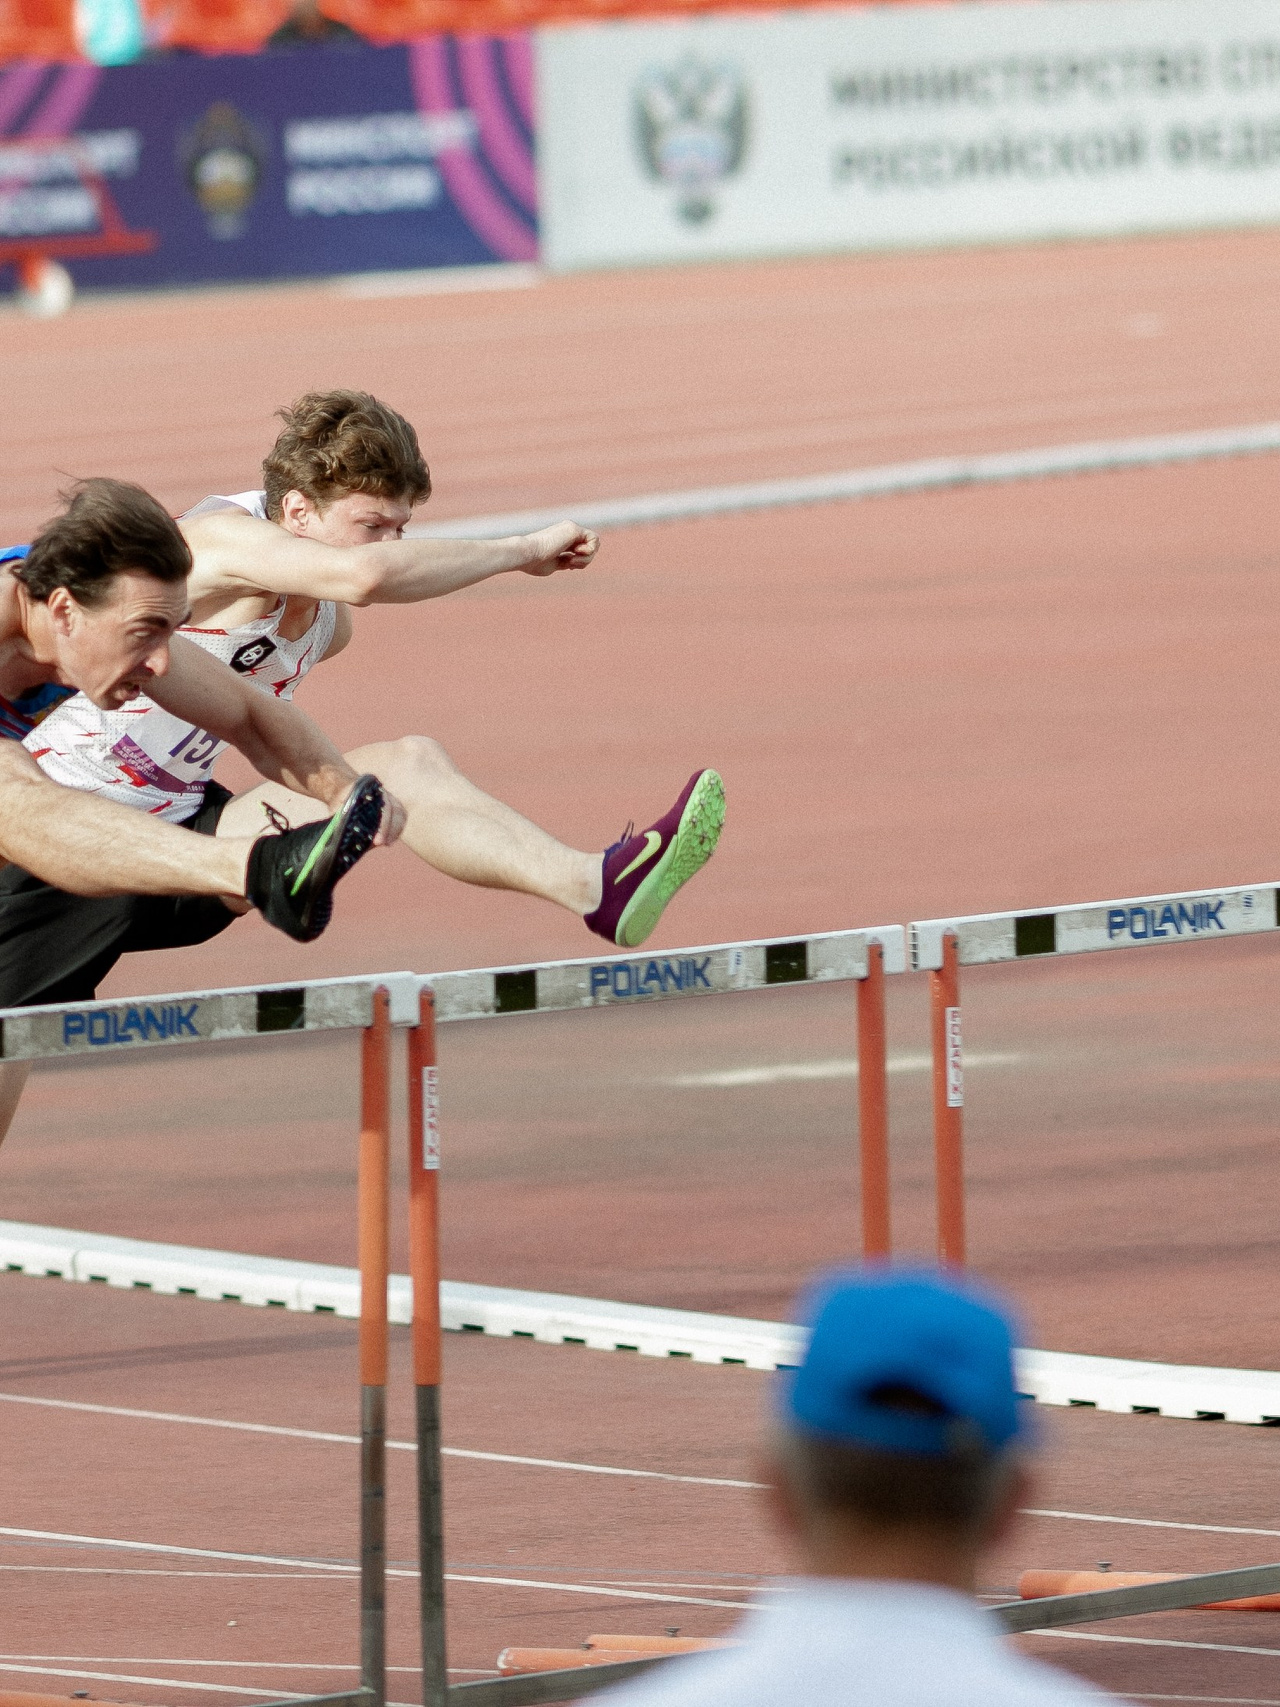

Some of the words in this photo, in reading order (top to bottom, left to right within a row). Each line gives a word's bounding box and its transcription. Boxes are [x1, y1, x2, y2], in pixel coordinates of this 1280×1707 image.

[1109, 900, 1226, 940] POLANIK
[590, 957, 712, 997] POLANIK
[63, 1004, 199, 1046] POLANIK
